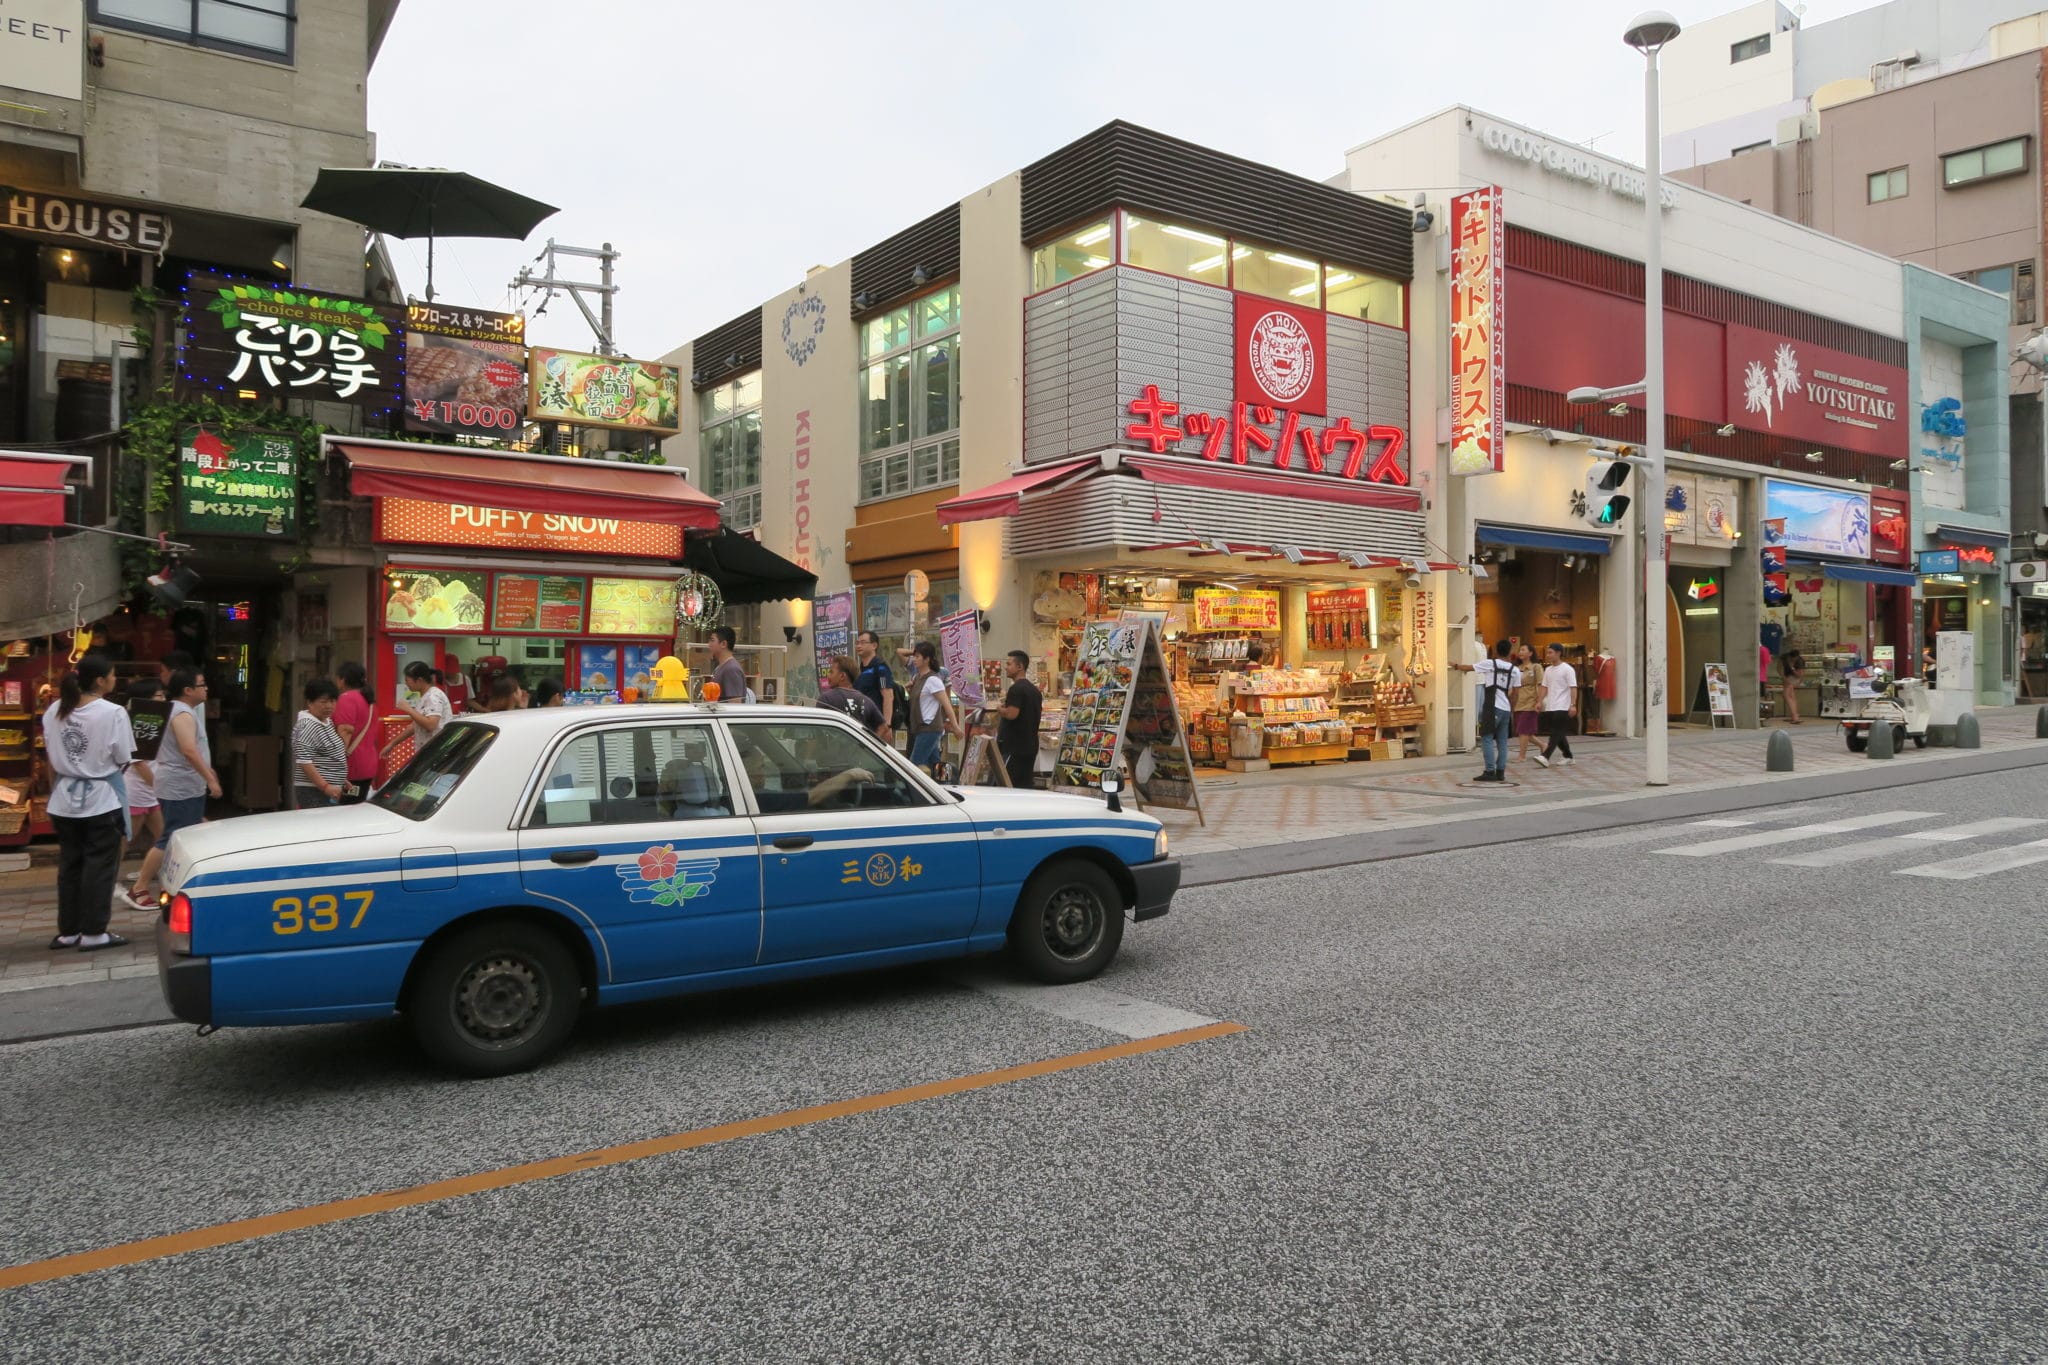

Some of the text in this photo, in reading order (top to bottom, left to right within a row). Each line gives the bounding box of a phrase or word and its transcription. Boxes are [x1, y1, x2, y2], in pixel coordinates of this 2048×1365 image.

[0, 18, 72, 44] EET
[1612, 171, 1680, 208] TERRSSE
[9, 195, 164, 248] HOUSE
[235, 312, 366, 362] ごりら
[1462, 217, 1489, 418] キッドハウス
[227, 351, 380, 398] パンチ
[1452, 375, 1461, 396] KID
[1452, 397, 1461, 429] HOUSE
[1806, 382, 1896, 420] YOTSUTAKE
[1126, 384, 1409, 486] キッドハウス
[795, 409, 811, 571] KID HOUS
[450, 504, 619, 535] PUFFY SNOW
[841, 855, 923, 883] 三 和
[272, 890, 375, 935] 337
